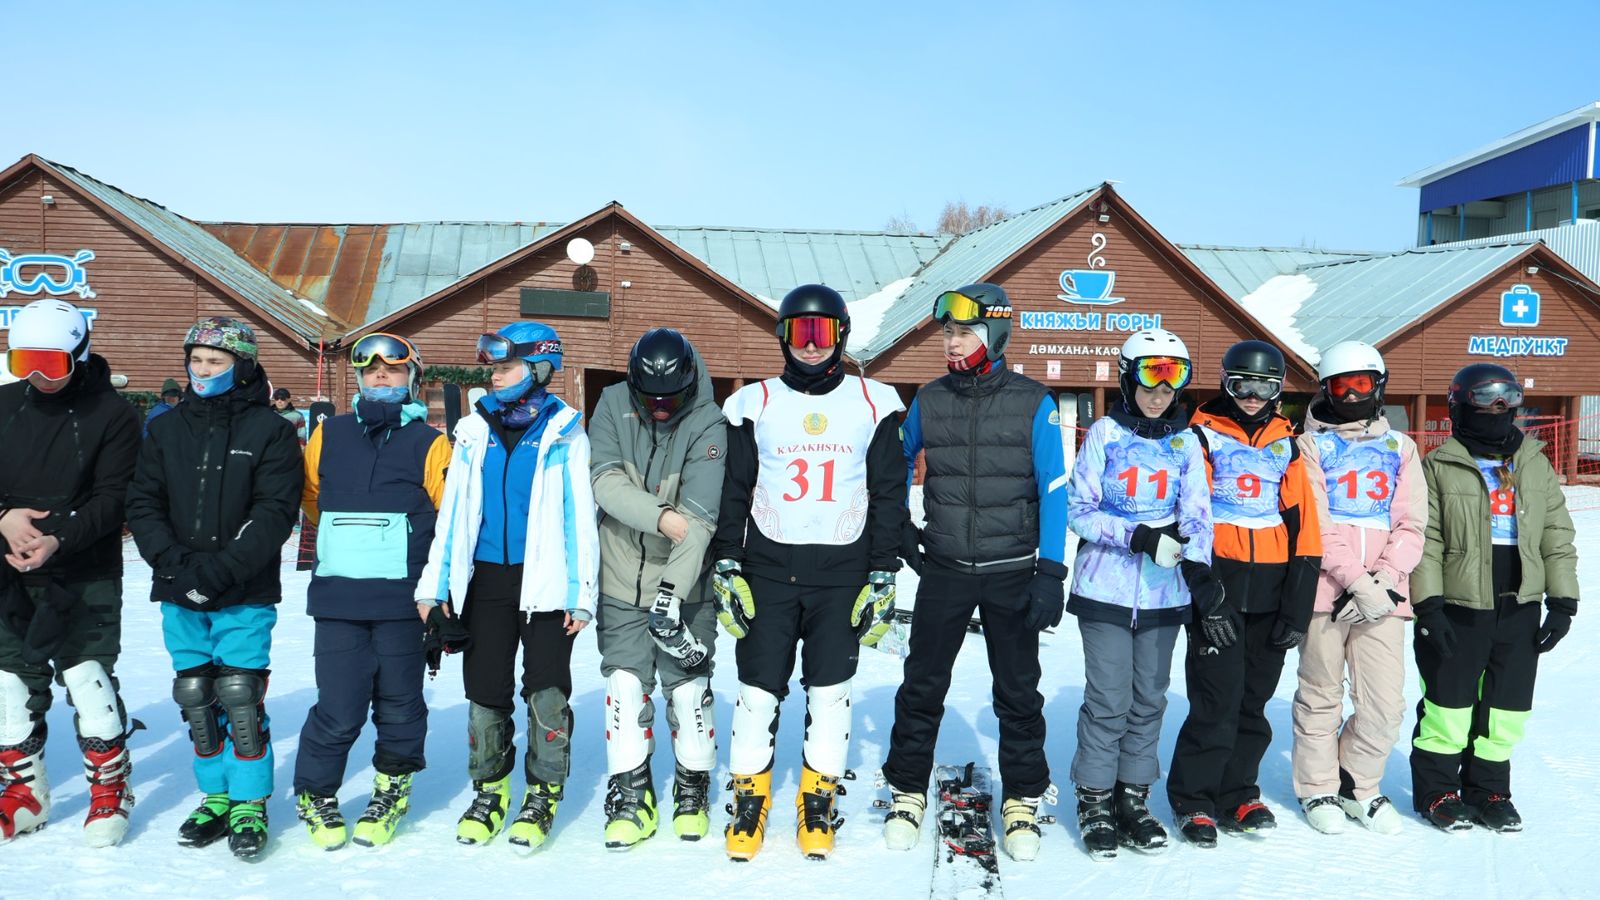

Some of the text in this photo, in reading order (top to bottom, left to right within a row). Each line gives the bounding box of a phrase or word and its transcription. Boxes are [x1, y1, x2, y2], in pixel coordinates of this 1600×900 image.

[985, 305, 1013, 317] 100
[1020, 312, 1161, 331] КНЯЖЬИ ГОРЫ
[1468, 336, 1568, 356] МЕДПУНКТ
[777, 444, 853, 454] KAZAKHSTAN
[783, 458, 837, 502] 31
[1118, 466, 1168, 499] 11
[1236, 474, 1261, 498] 9
[1337, 470, 1390, 500] 13
[694, 708, 703, 733] LEKI
